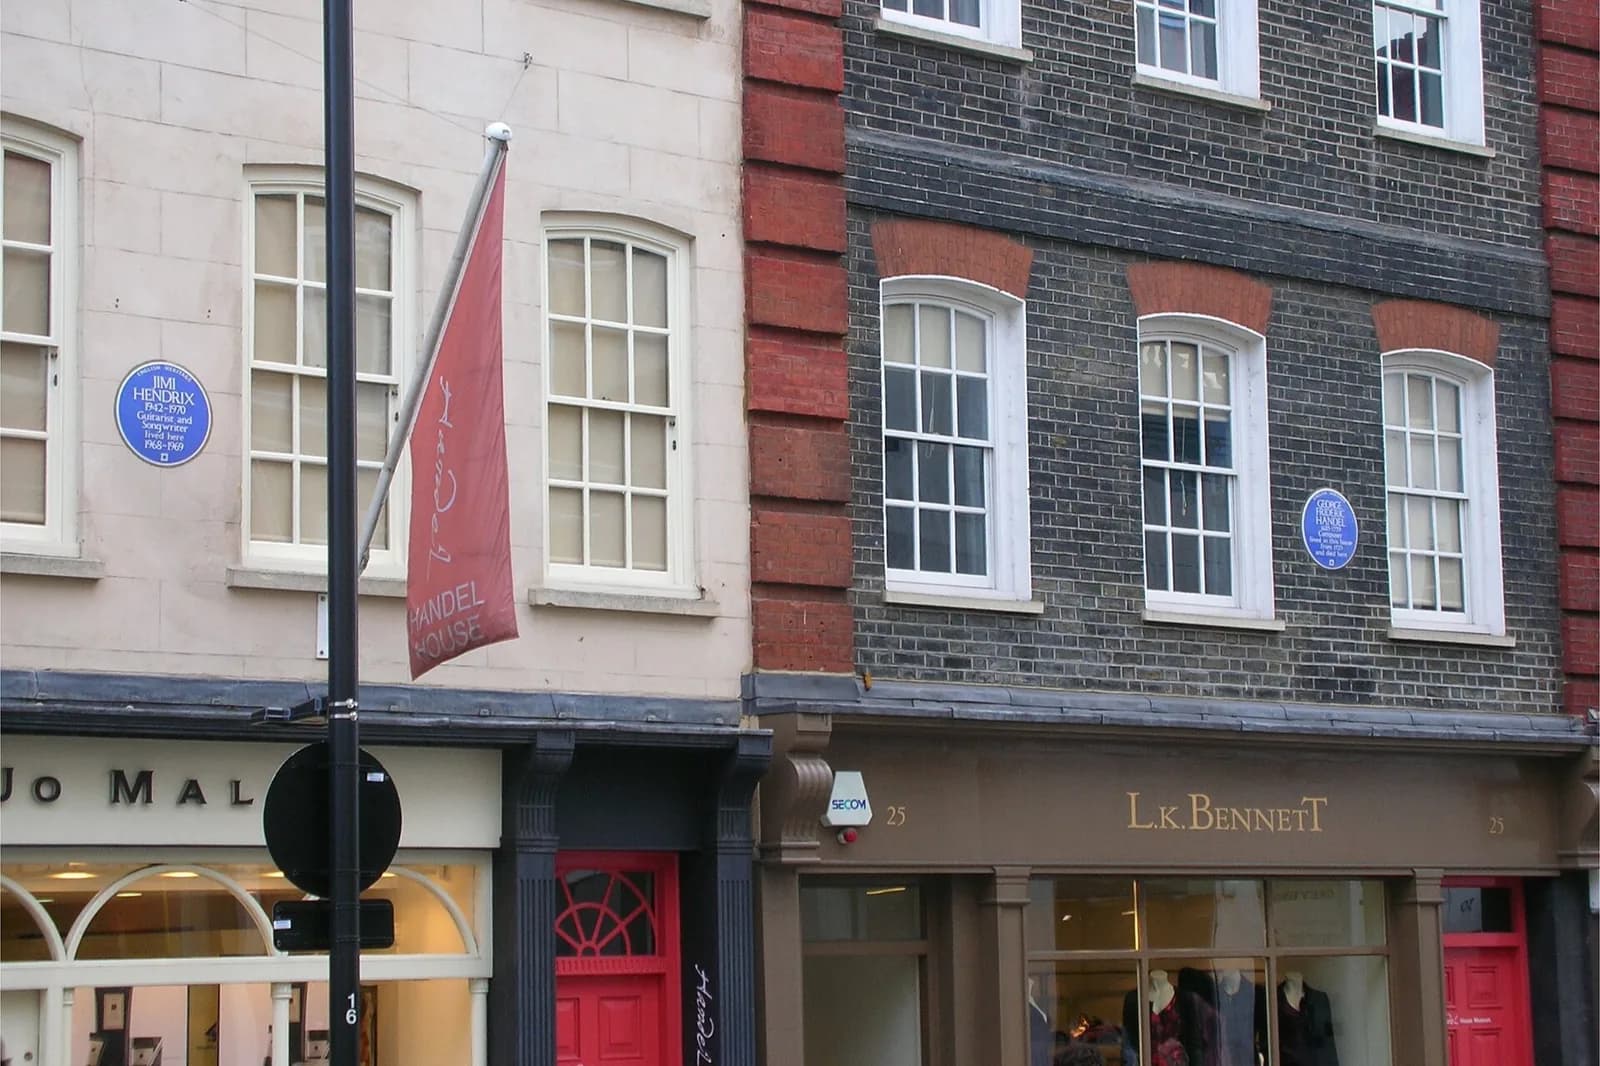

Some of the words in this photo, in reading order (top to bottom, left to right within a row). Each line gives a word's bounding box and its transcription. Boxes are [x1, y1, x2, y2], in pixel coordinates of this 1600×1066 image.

[153, 375, 176, 390] JIMI
[133, 387, 195, 406] HENDRIX
[144, 402, 186, 415] 1942-1970
[136, 410, 174, 423] Guitarist
[177, 416, 193, 425] and
[142, 420, 188, 433] Songwriter
[144, 430, 165, 440] lived
[167, 432, 185, 441] here
[144, 439, 185, 451] 1968-1969
[1315, 516, 1347, 527] HANDEL
[408, 580, 485, 633] HANDEL
[414, 615, 485, 660] HOUSE
[109, 769, 255, 805] MAL
[831, 799, 867, 811] SECOM
[887, 805, 906, 826] 25
[1489, 816, 1505, 834] 25
